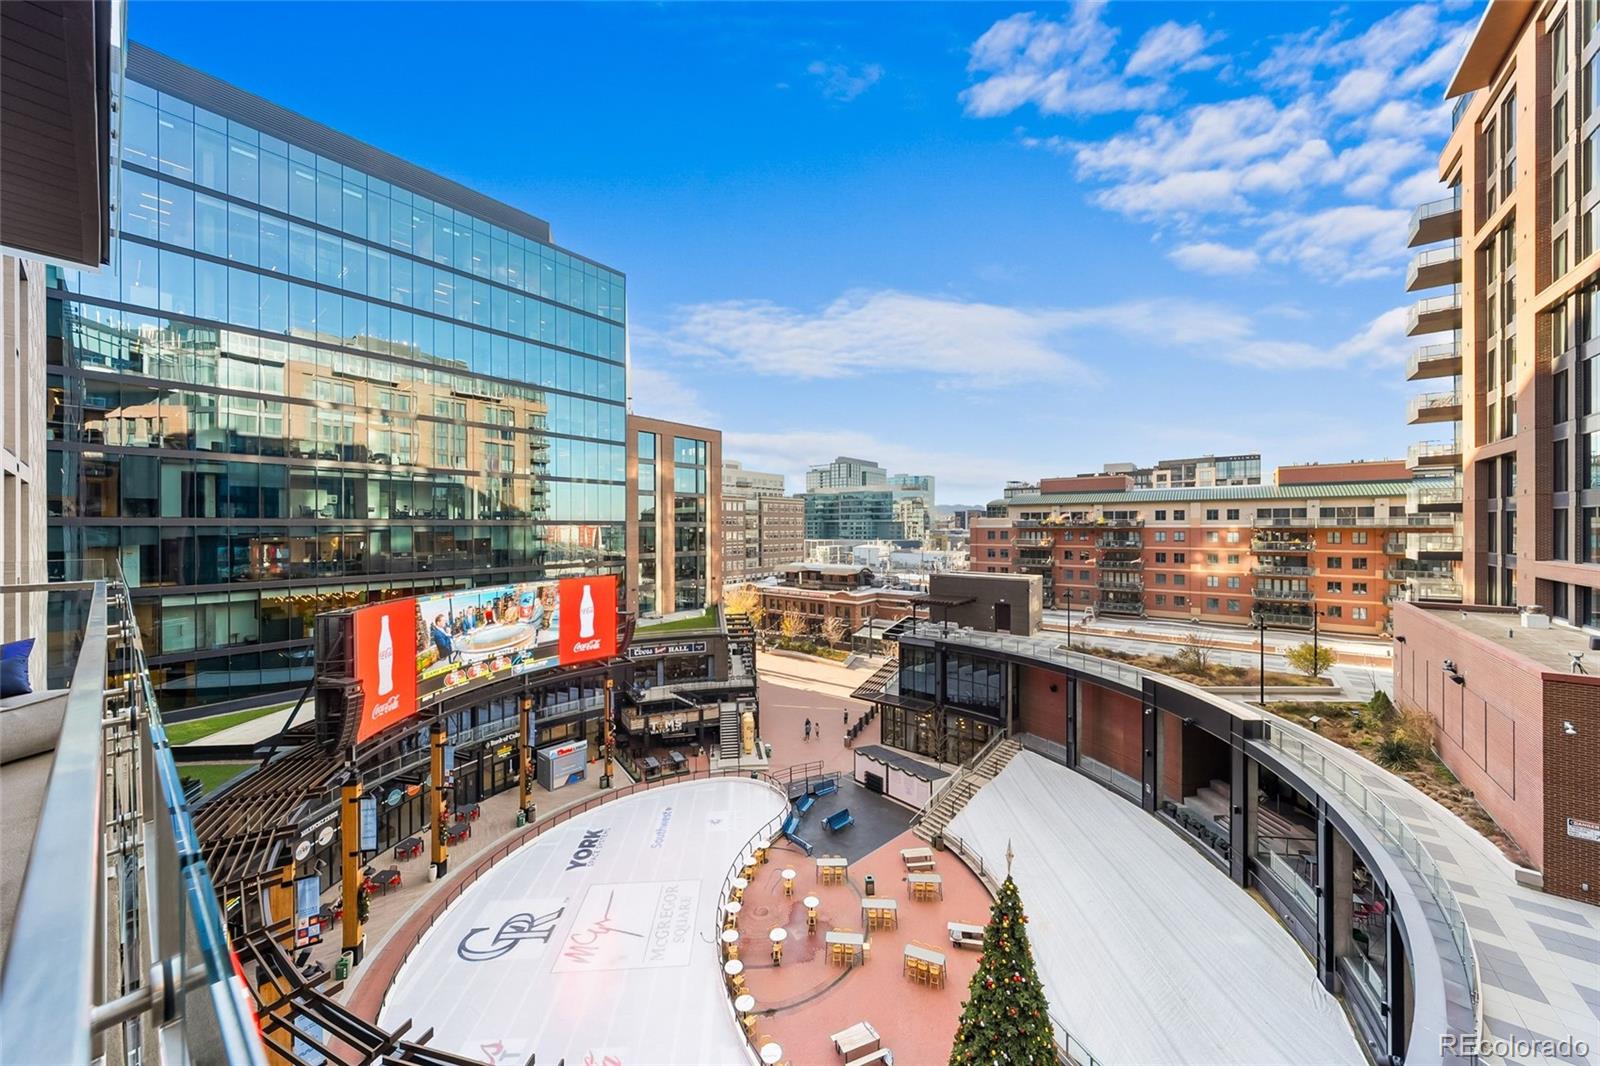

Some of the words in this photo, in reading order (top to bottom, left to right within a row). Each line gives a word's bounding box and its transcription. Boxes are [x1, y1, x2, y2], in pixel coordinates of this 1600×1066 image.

[668, 645, 689, 653] HALL
[565, 829, 604, 871] YORK
[673, 896, 692, 944] SQUARE
